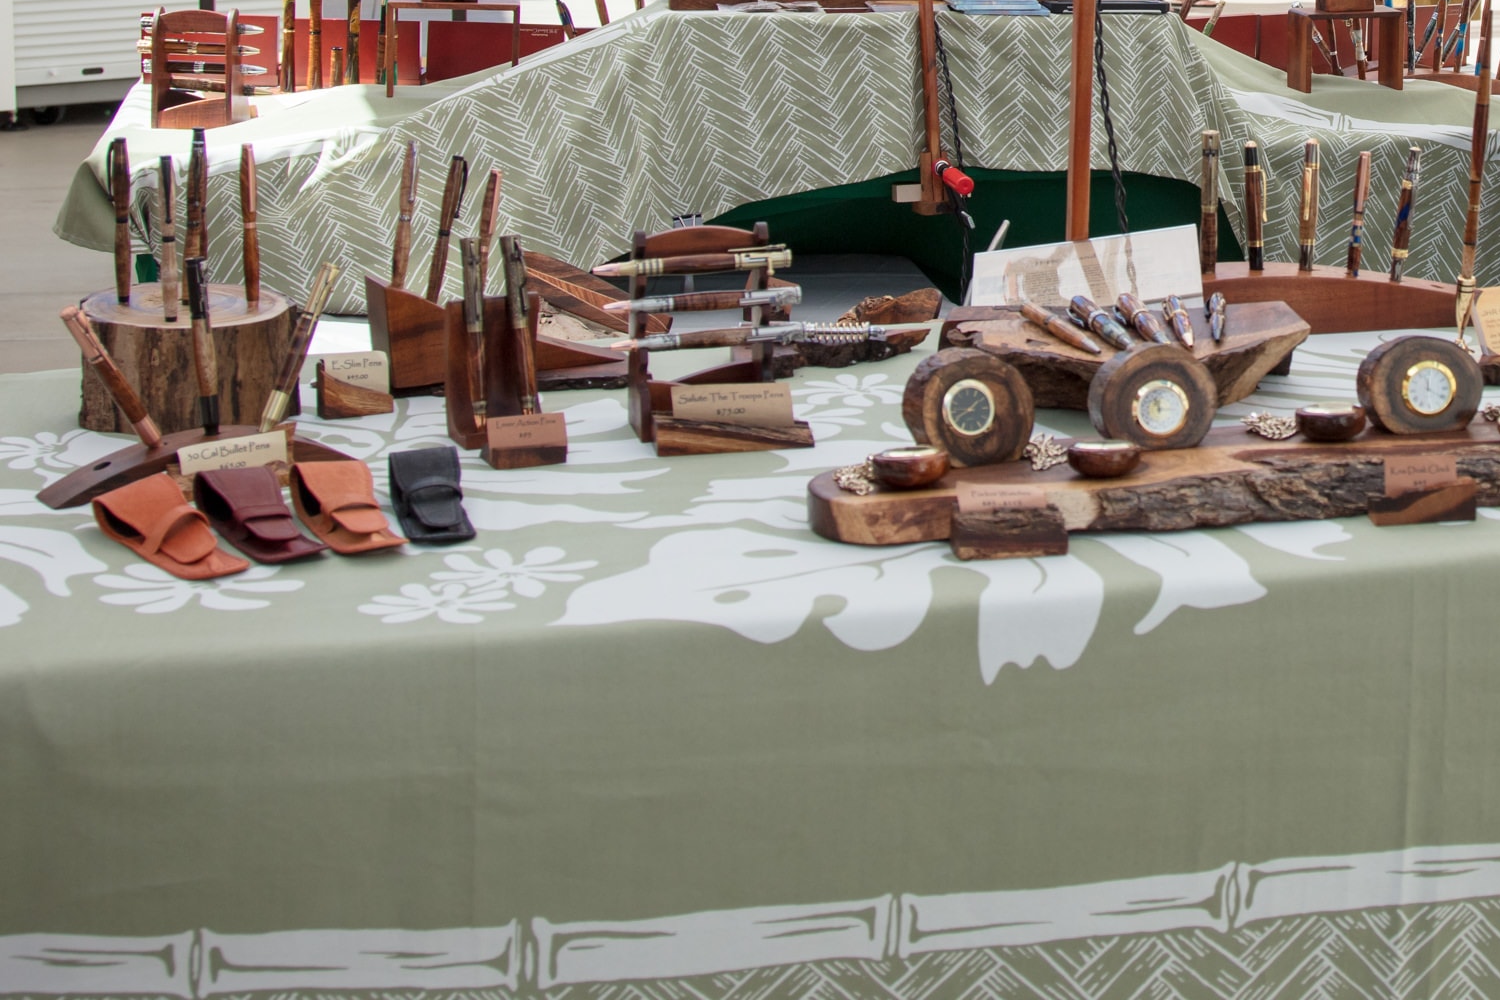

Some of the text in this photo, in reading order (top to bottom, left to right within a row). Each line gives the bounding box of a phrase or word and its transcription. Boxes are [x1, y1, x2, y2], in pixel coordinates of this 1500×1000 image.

[363, 358, 382, 368] Pens
[678, 390, 784, 405] Salute The Troops Pens
[201, 448, 218, 460] Cal
[220, 444, 248, 458] Bullet
[249, 441, 271, 453] Pens
